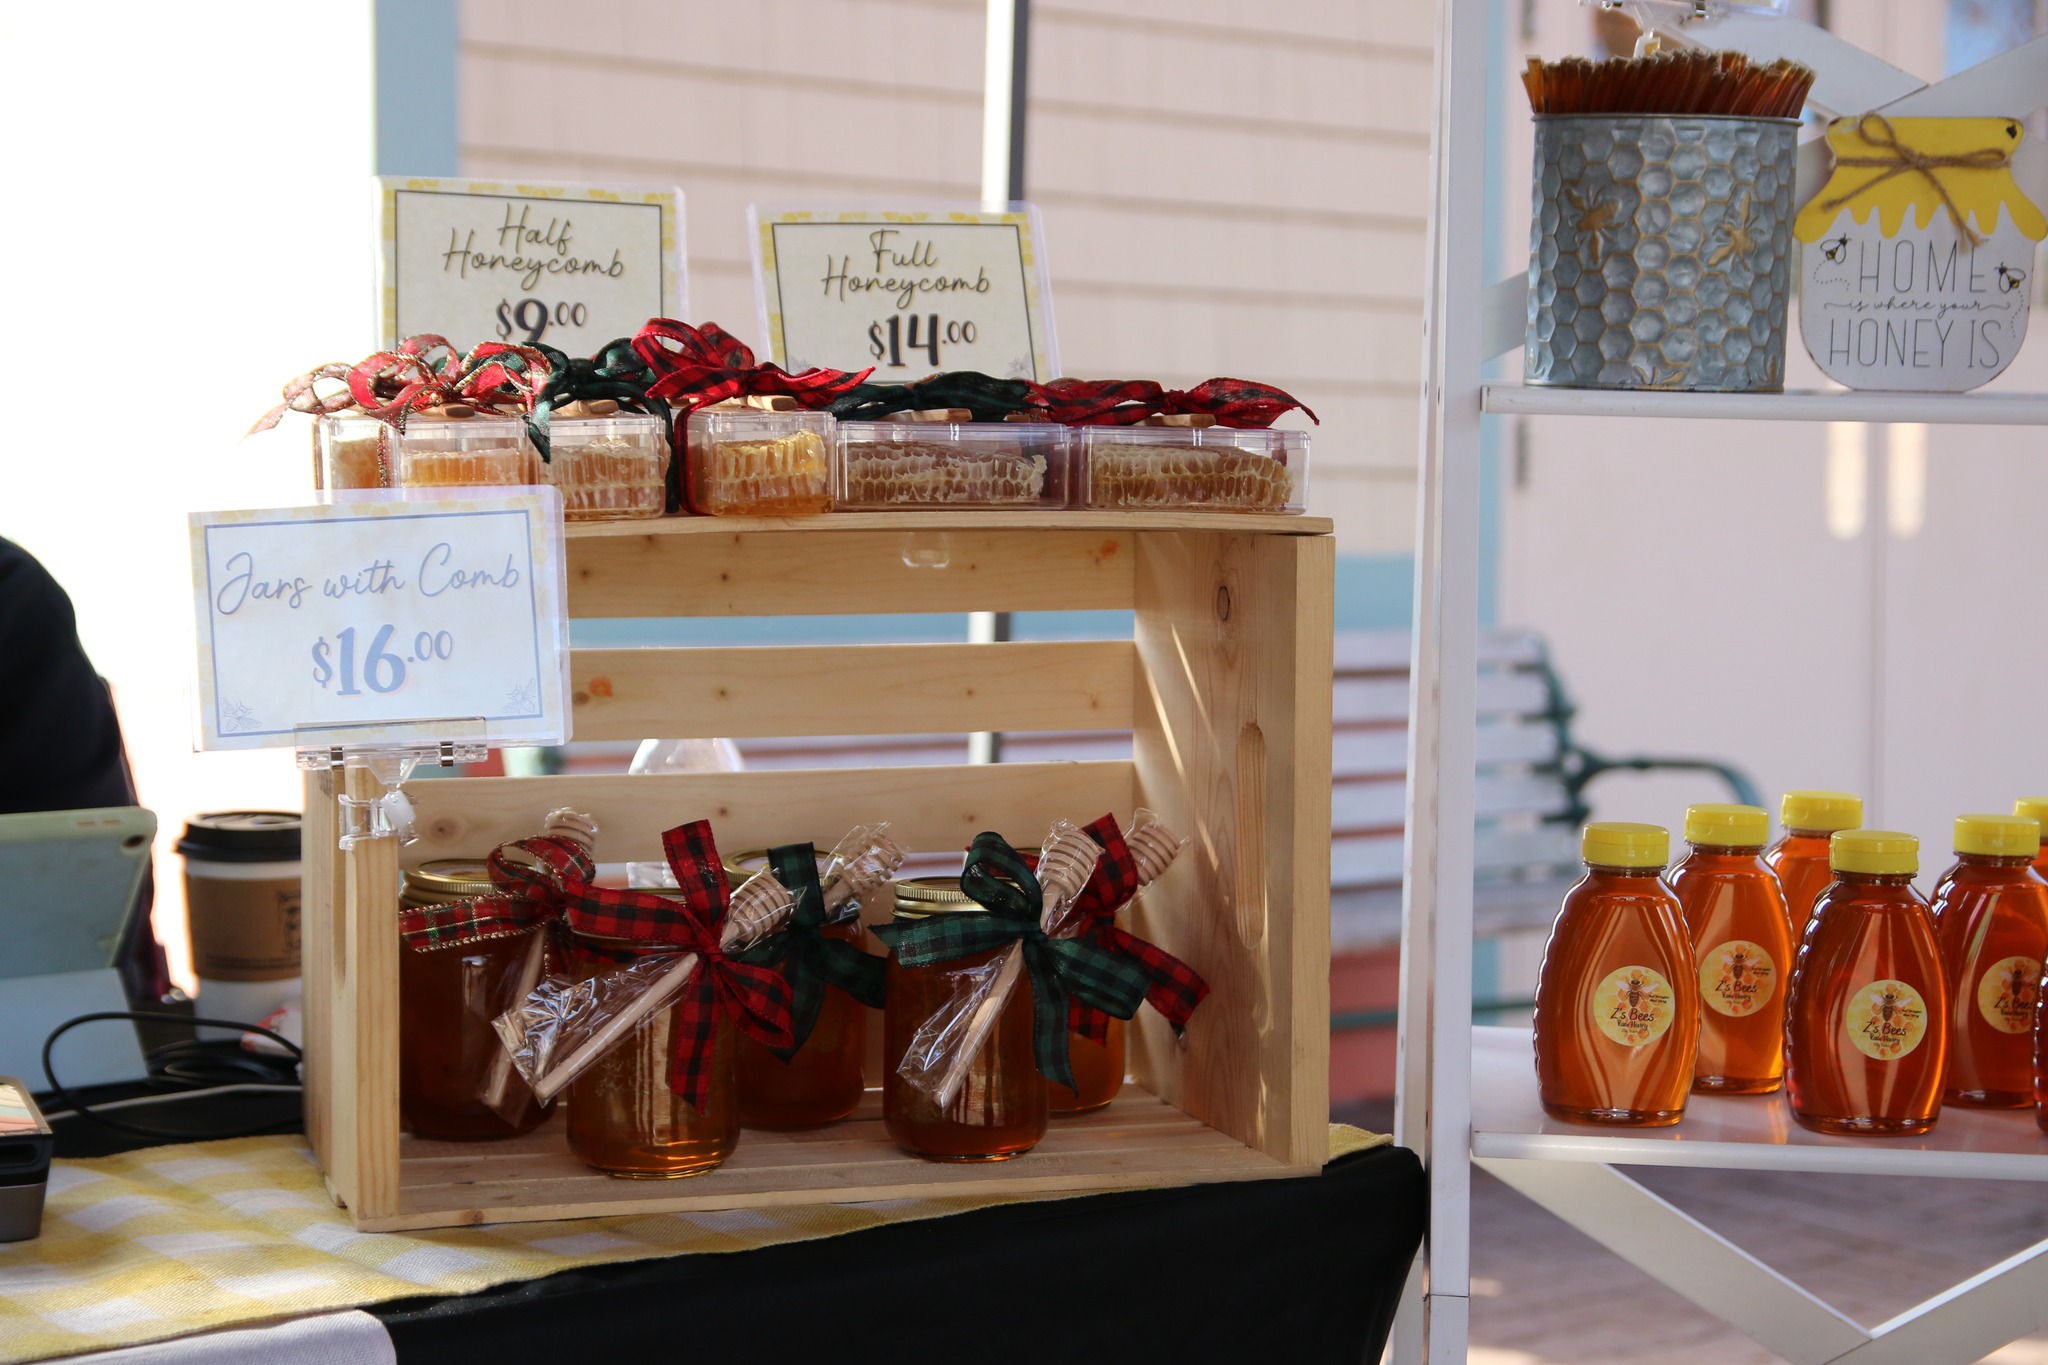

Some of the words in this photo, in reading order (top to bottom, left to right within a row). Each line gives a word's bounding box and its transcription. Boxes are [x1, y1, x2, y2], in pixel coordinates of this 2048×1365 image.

[497, 202, 573, 256] Half
[868, 229, 938, 271] Full
[442, 227, 625, 291] Honeycomb
[820, 254, 991, 309] Honeycomb
[1859, 239, 1989, 293] HOME
[495, 297, 588, 343] $9.00
[1873, 295, 1937, 310] where
[867, 312, 976, 368] $14.00
[1829, 317, 1955, 367] HONEY
[1967, 319, 2001, 369] IS
[216, 551, 313, 615] Jars
[322, 559, 406, 599] with
[418, 542, 520, 597] Comb
[311, 623, 453, 697] $16.00
[1733, 980, 1757, 993] Bees
[1610, 1007, 1626, 1019] Z's
[1629, 1008, 1654, 1021] Bees
[1863, 1021, 1879, 1033] Z's
[1882, 1022, 1907, 1036] Bees
